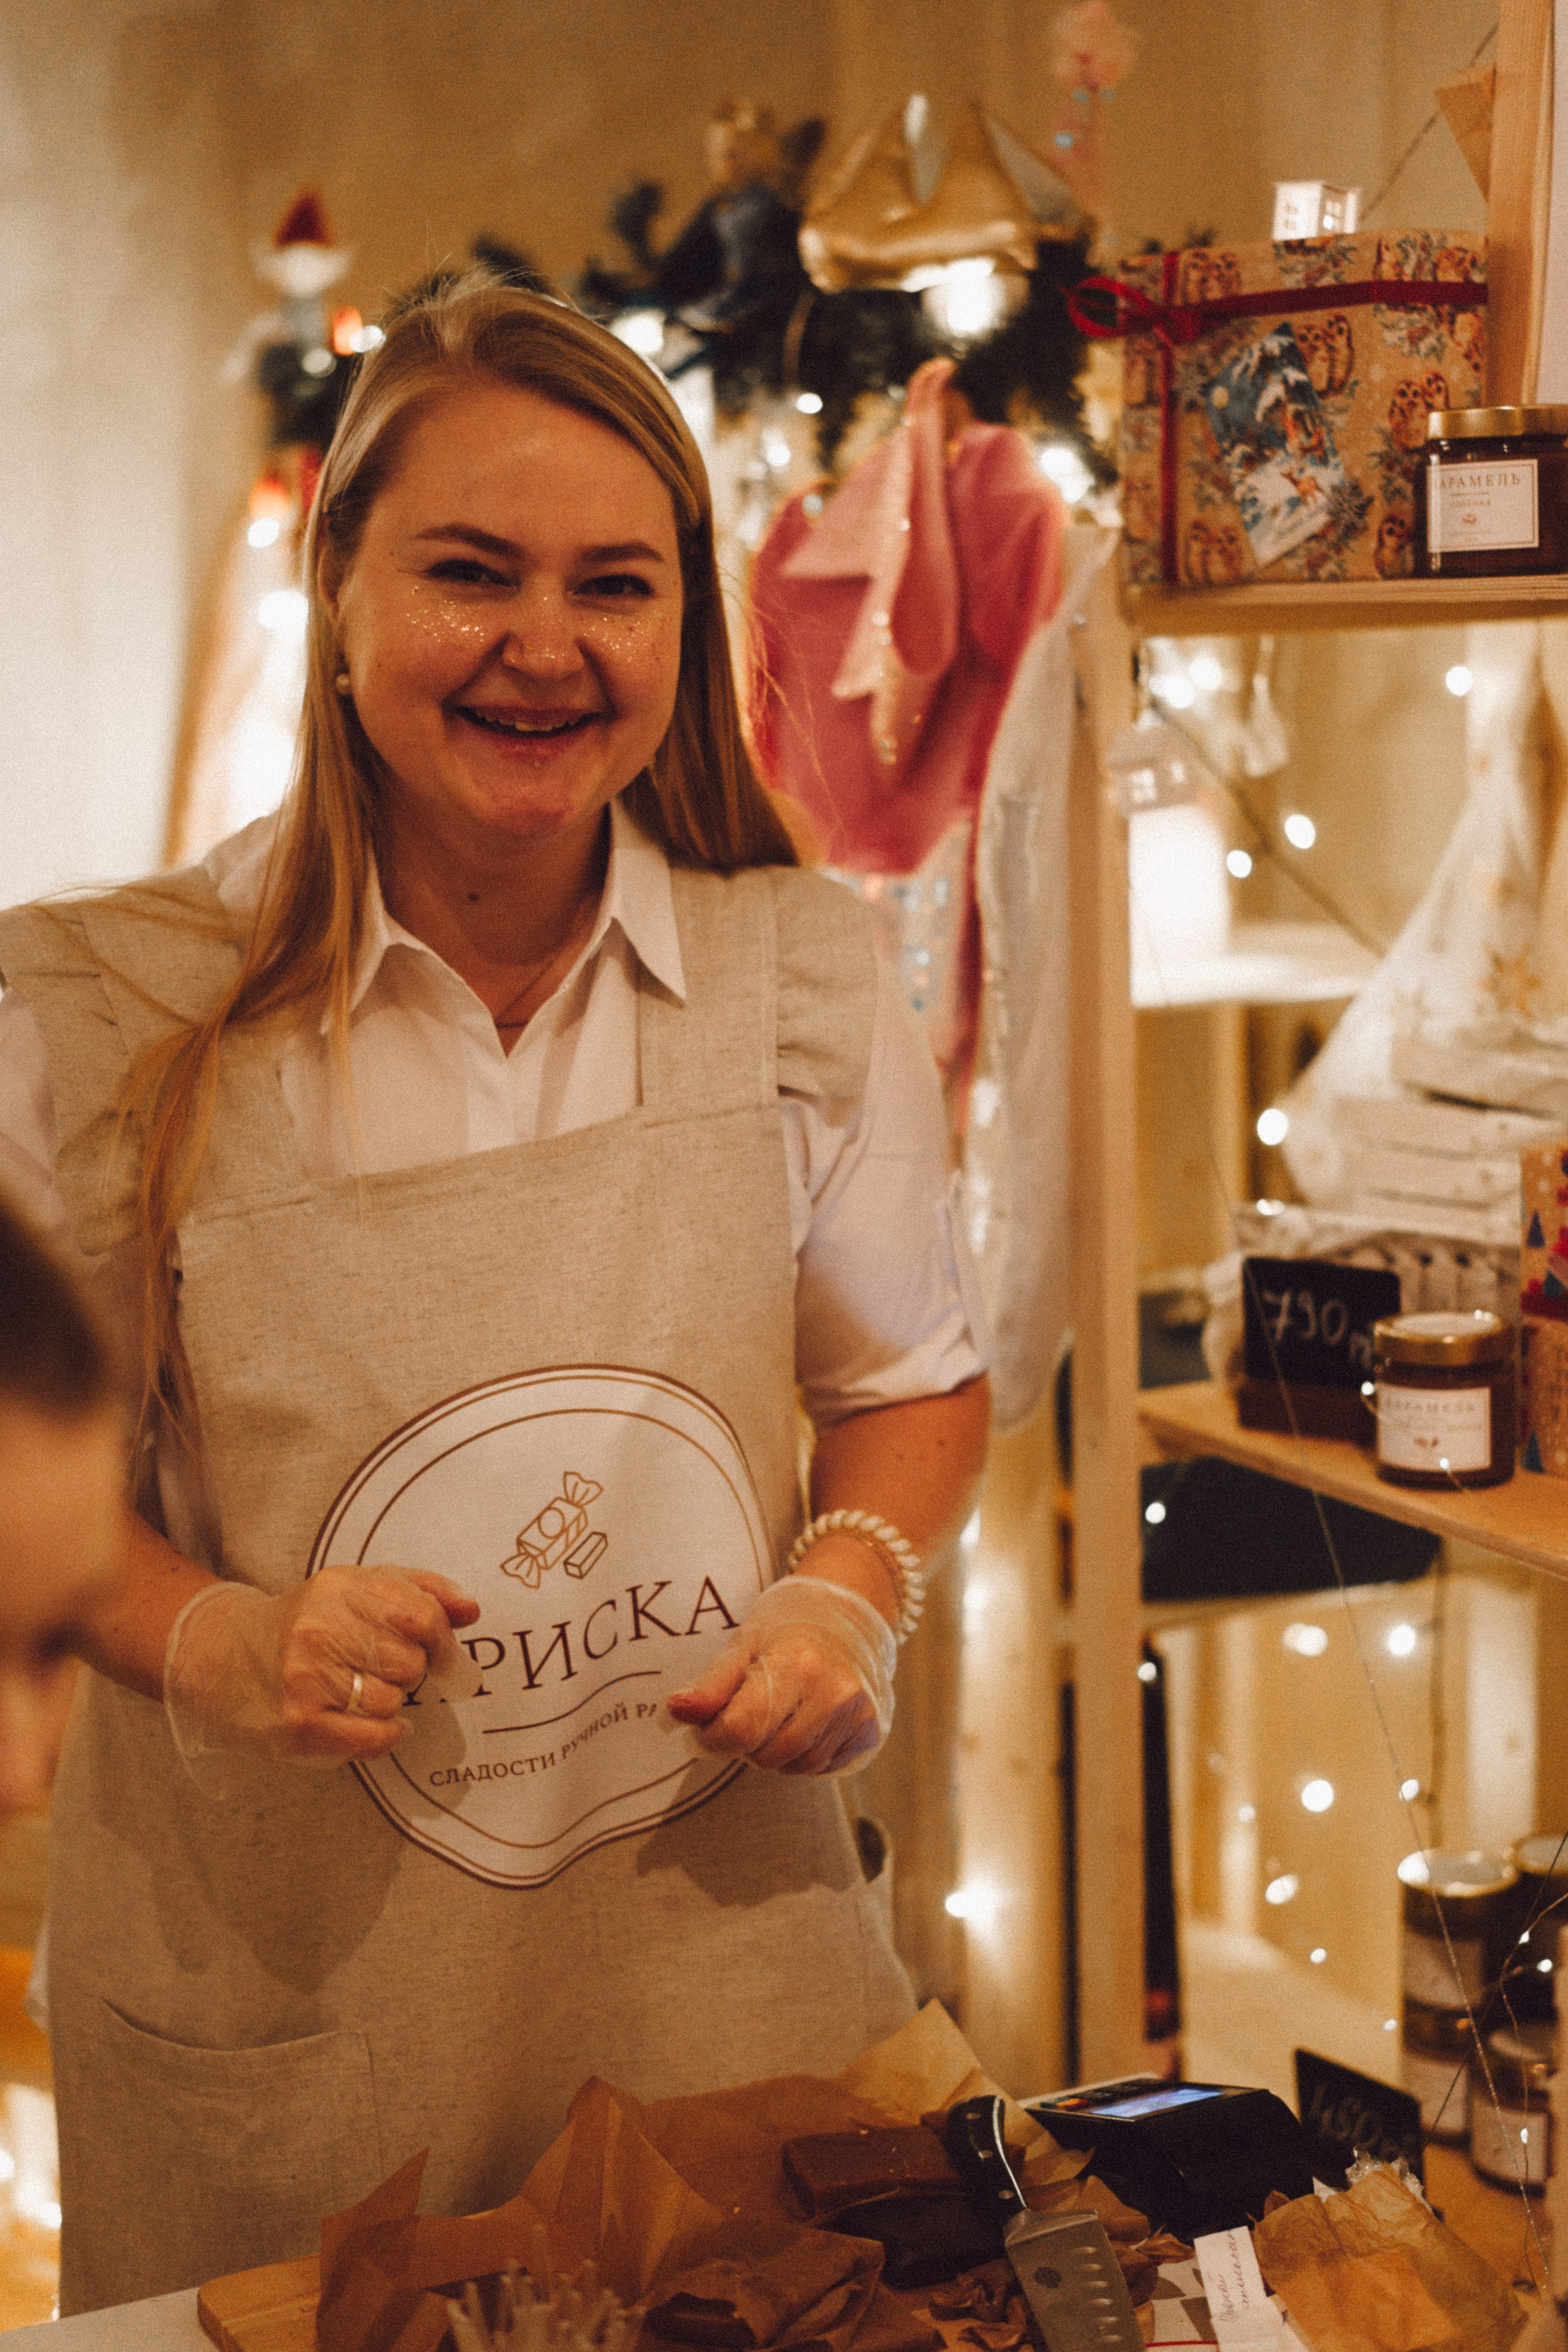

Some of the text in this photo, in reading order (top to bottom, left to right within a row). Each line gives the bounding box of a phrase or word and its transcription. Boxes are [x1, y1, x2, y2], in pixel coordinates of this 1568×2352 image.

[1438, 472, 1520, 489] АРАМЕЛЬ
[402, 1576, 740, 1706] РИСКА
[430, 1702, 628, 1787] СЛАДОСТИ РУЧНОЙ
